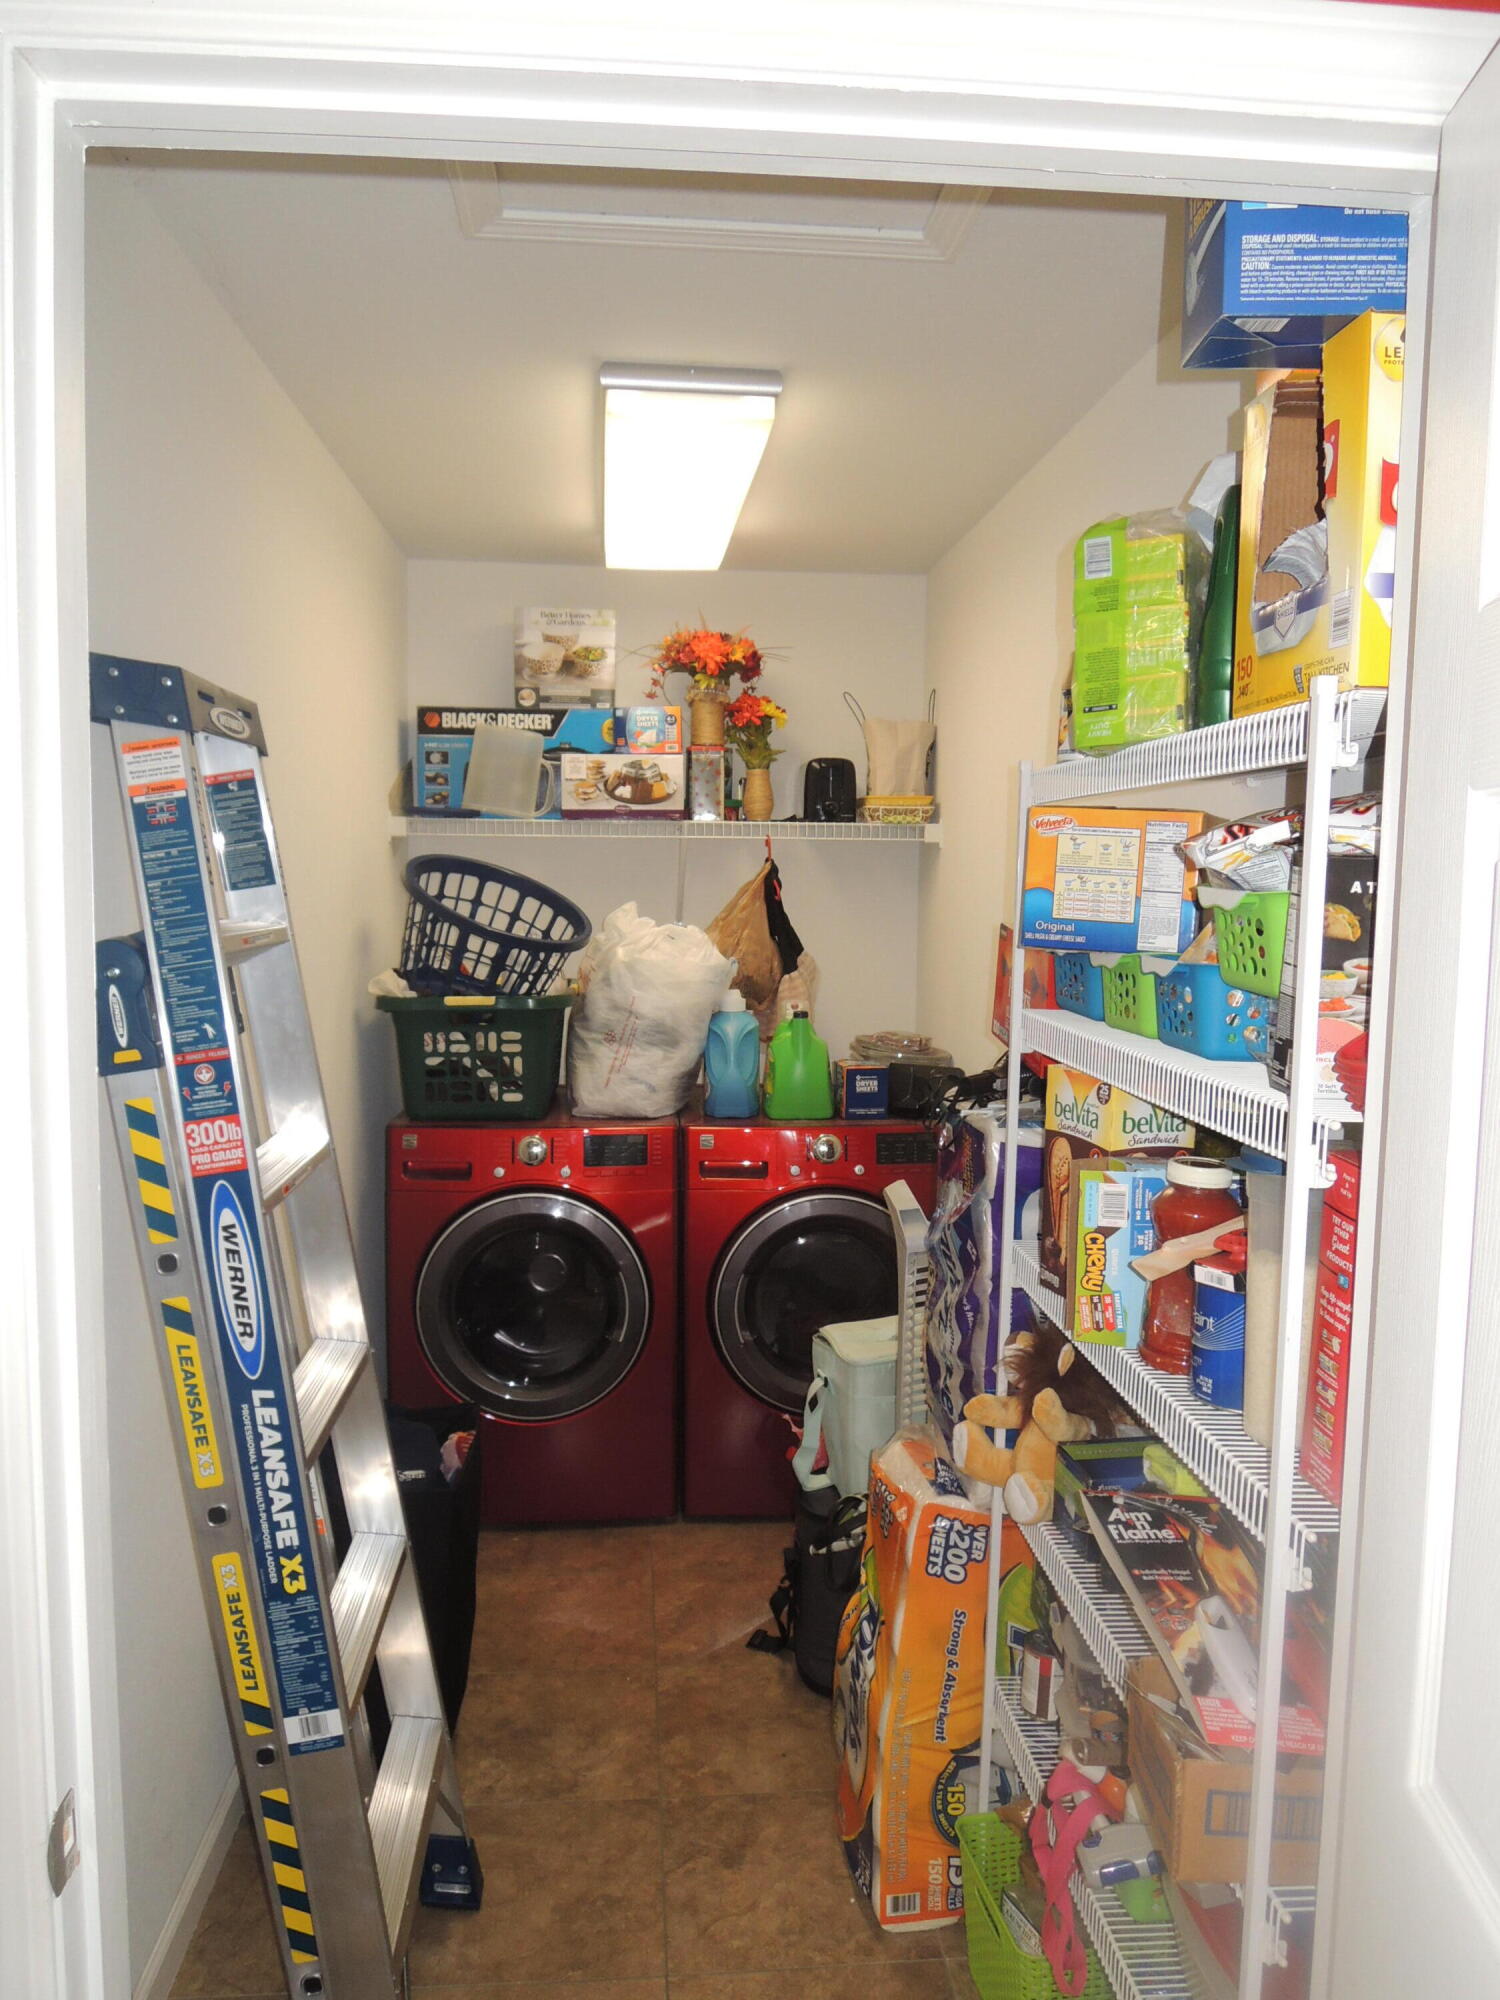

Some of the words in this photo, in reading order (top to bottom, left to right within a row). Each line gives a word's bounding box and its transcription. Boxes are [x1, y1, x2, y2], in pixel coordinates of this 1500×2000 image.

[1242, 236, 1271, 244] STORAGE
[1272, 235, 1286, 243] AND
[1287, 234, 1320, 243] DISPOSAL:
[1242, 262, 1270, 270] CAUTION:
[1236, 655, 1253, 682] 150
[1317, 661, 1350, 677] KITCHEN
[1036, 816, 1074, 830] Velveeta
[1036, 921, 1075, 934] Original
[1054, 1094, 1099, 1130] belVita
[1122, 1104, 1186, 1134] belVita
[186, 1120, 242, 1148] 300lb
[1058, 1119, 1093, 1140] Sandwich
[1128, 1133, 1180, 1146] Sandwich
[192, 1154, 212, 1165] PRO
[212, 1150, 244, 1162] GRADE
[1342, 1221, 1354, 1234] OUR
[1326, 1250, 1353, 1273] PRODUCTS
[220, 1223, 255, 1341] WERNER
[175, 1344, 210, 1448] LEANSAFE
[196, 1450, 214, 1478] X3
[240, 1404, 258, 1464] PROFESSIONAL
[254, 1486, 273, 1550] MULTI-PURPOSE
[266, 1551, 278, 1584] LADDER
[251, 1388, 298, 1551] LEANSAFE
[279, 1552, 307, 1596] X3
[926, 1515, 951, 1577] SHEETS
[971, 1526, 990, 1562] OVER
[1107, 1524, 1176, 1540] Flame
[944, 1520, 974, 1584] 2200
[219, 1564, 236, 1588] X3
[219, 1591, 258, 1692] LEANSAFE
[946, 1609, 967, 1657] Strong
[947, 1659, 959, 1669] &
[935, 1671, 957, 1743] Absorbent
[946, 1783, 966, 1816] 150
[928, 1857, 942, 1887] 150
